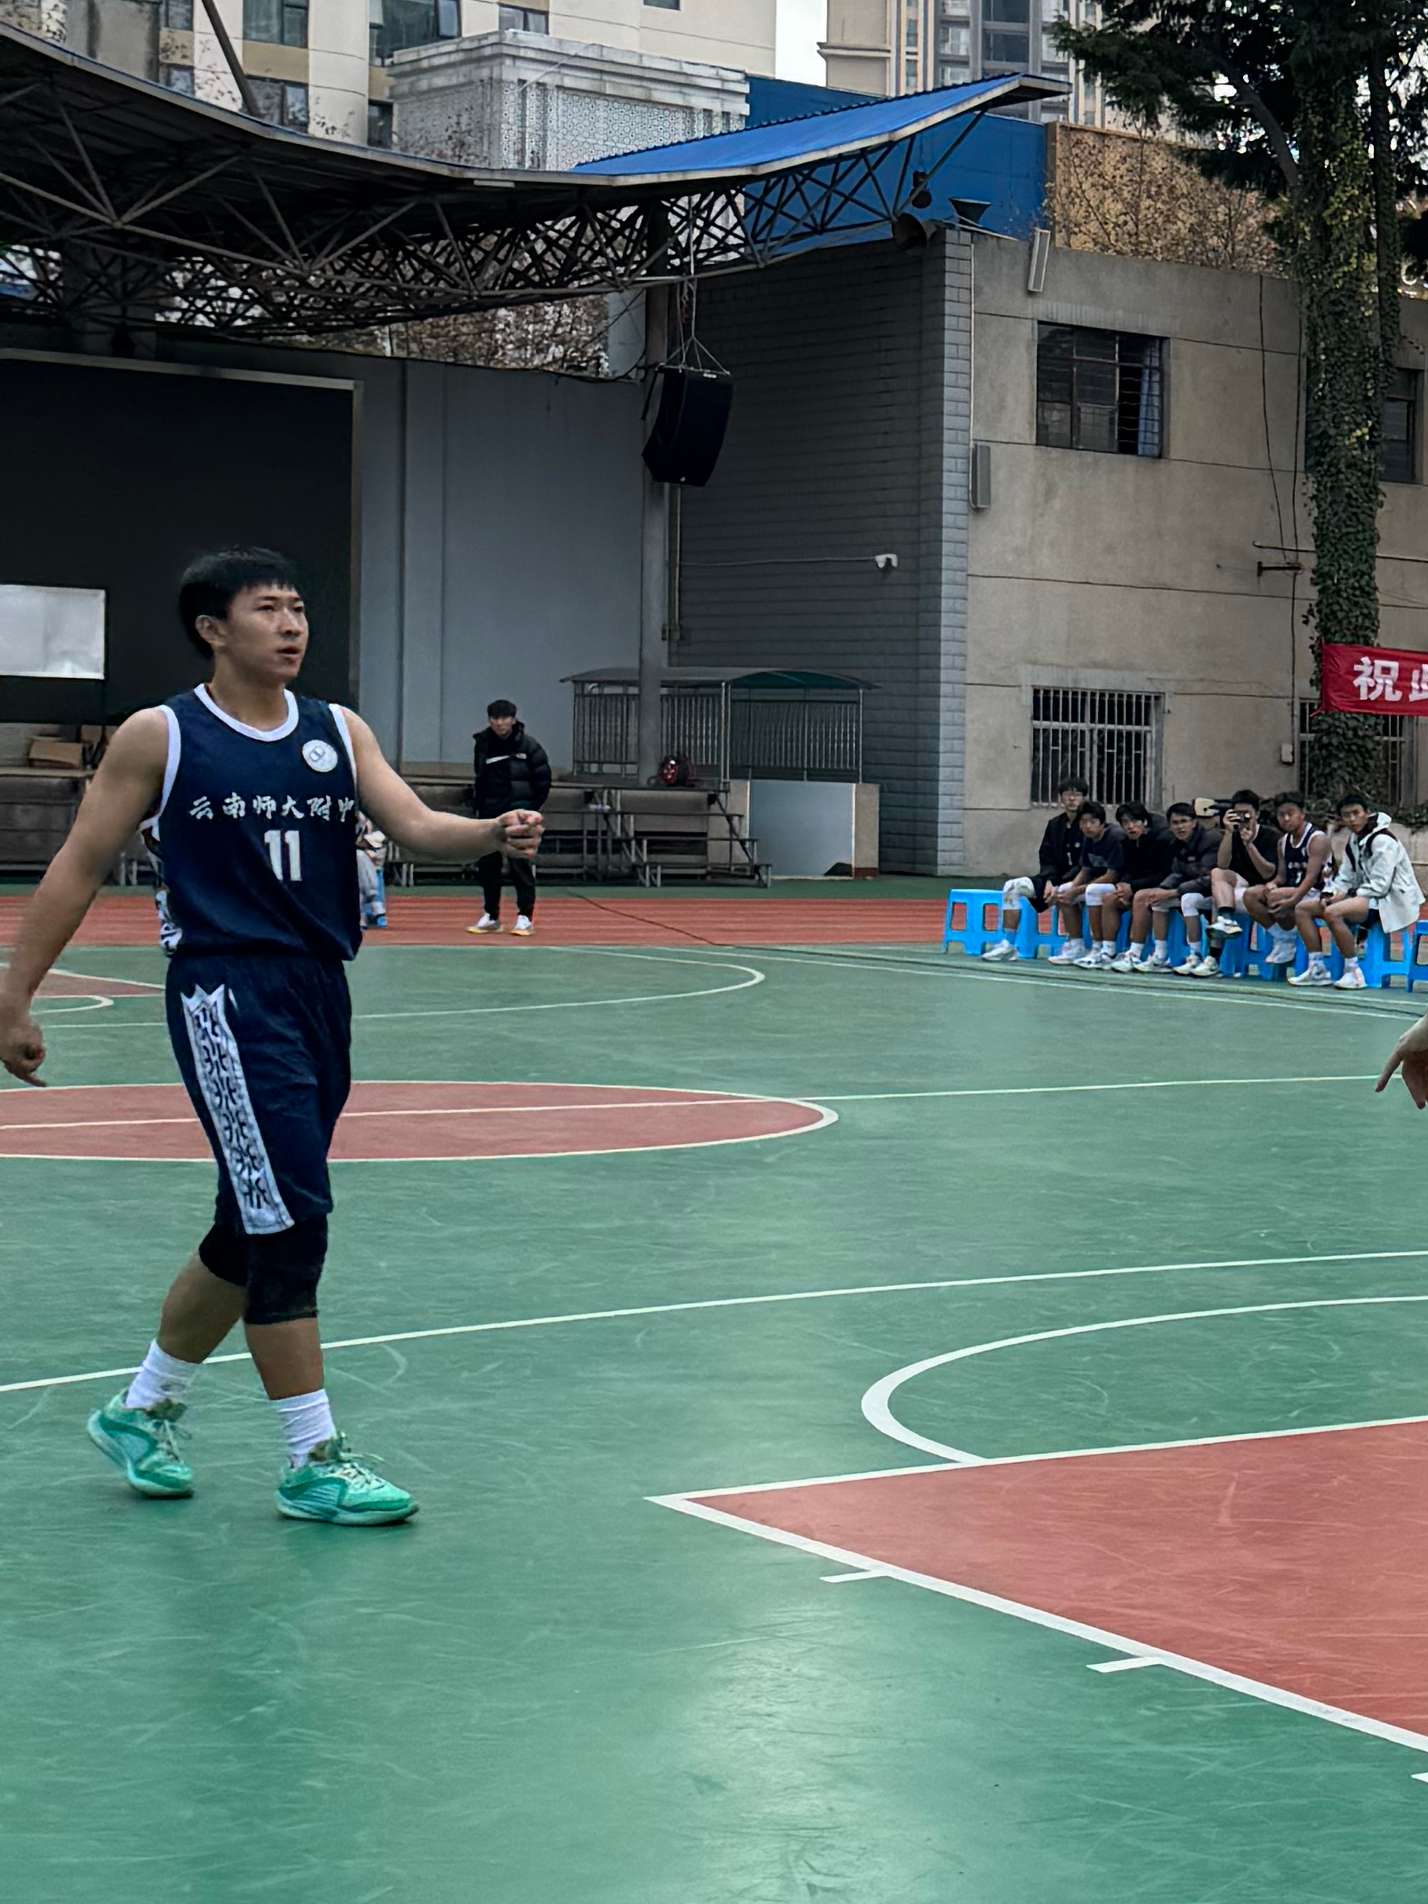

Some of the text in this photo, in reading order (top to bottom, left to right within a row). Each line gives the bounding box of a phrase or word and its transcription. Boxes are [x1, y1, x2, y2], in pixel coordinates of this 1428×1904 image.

[189, 792, 355, 822] 云南师大附中
[264, 829, 303, 881] 11
